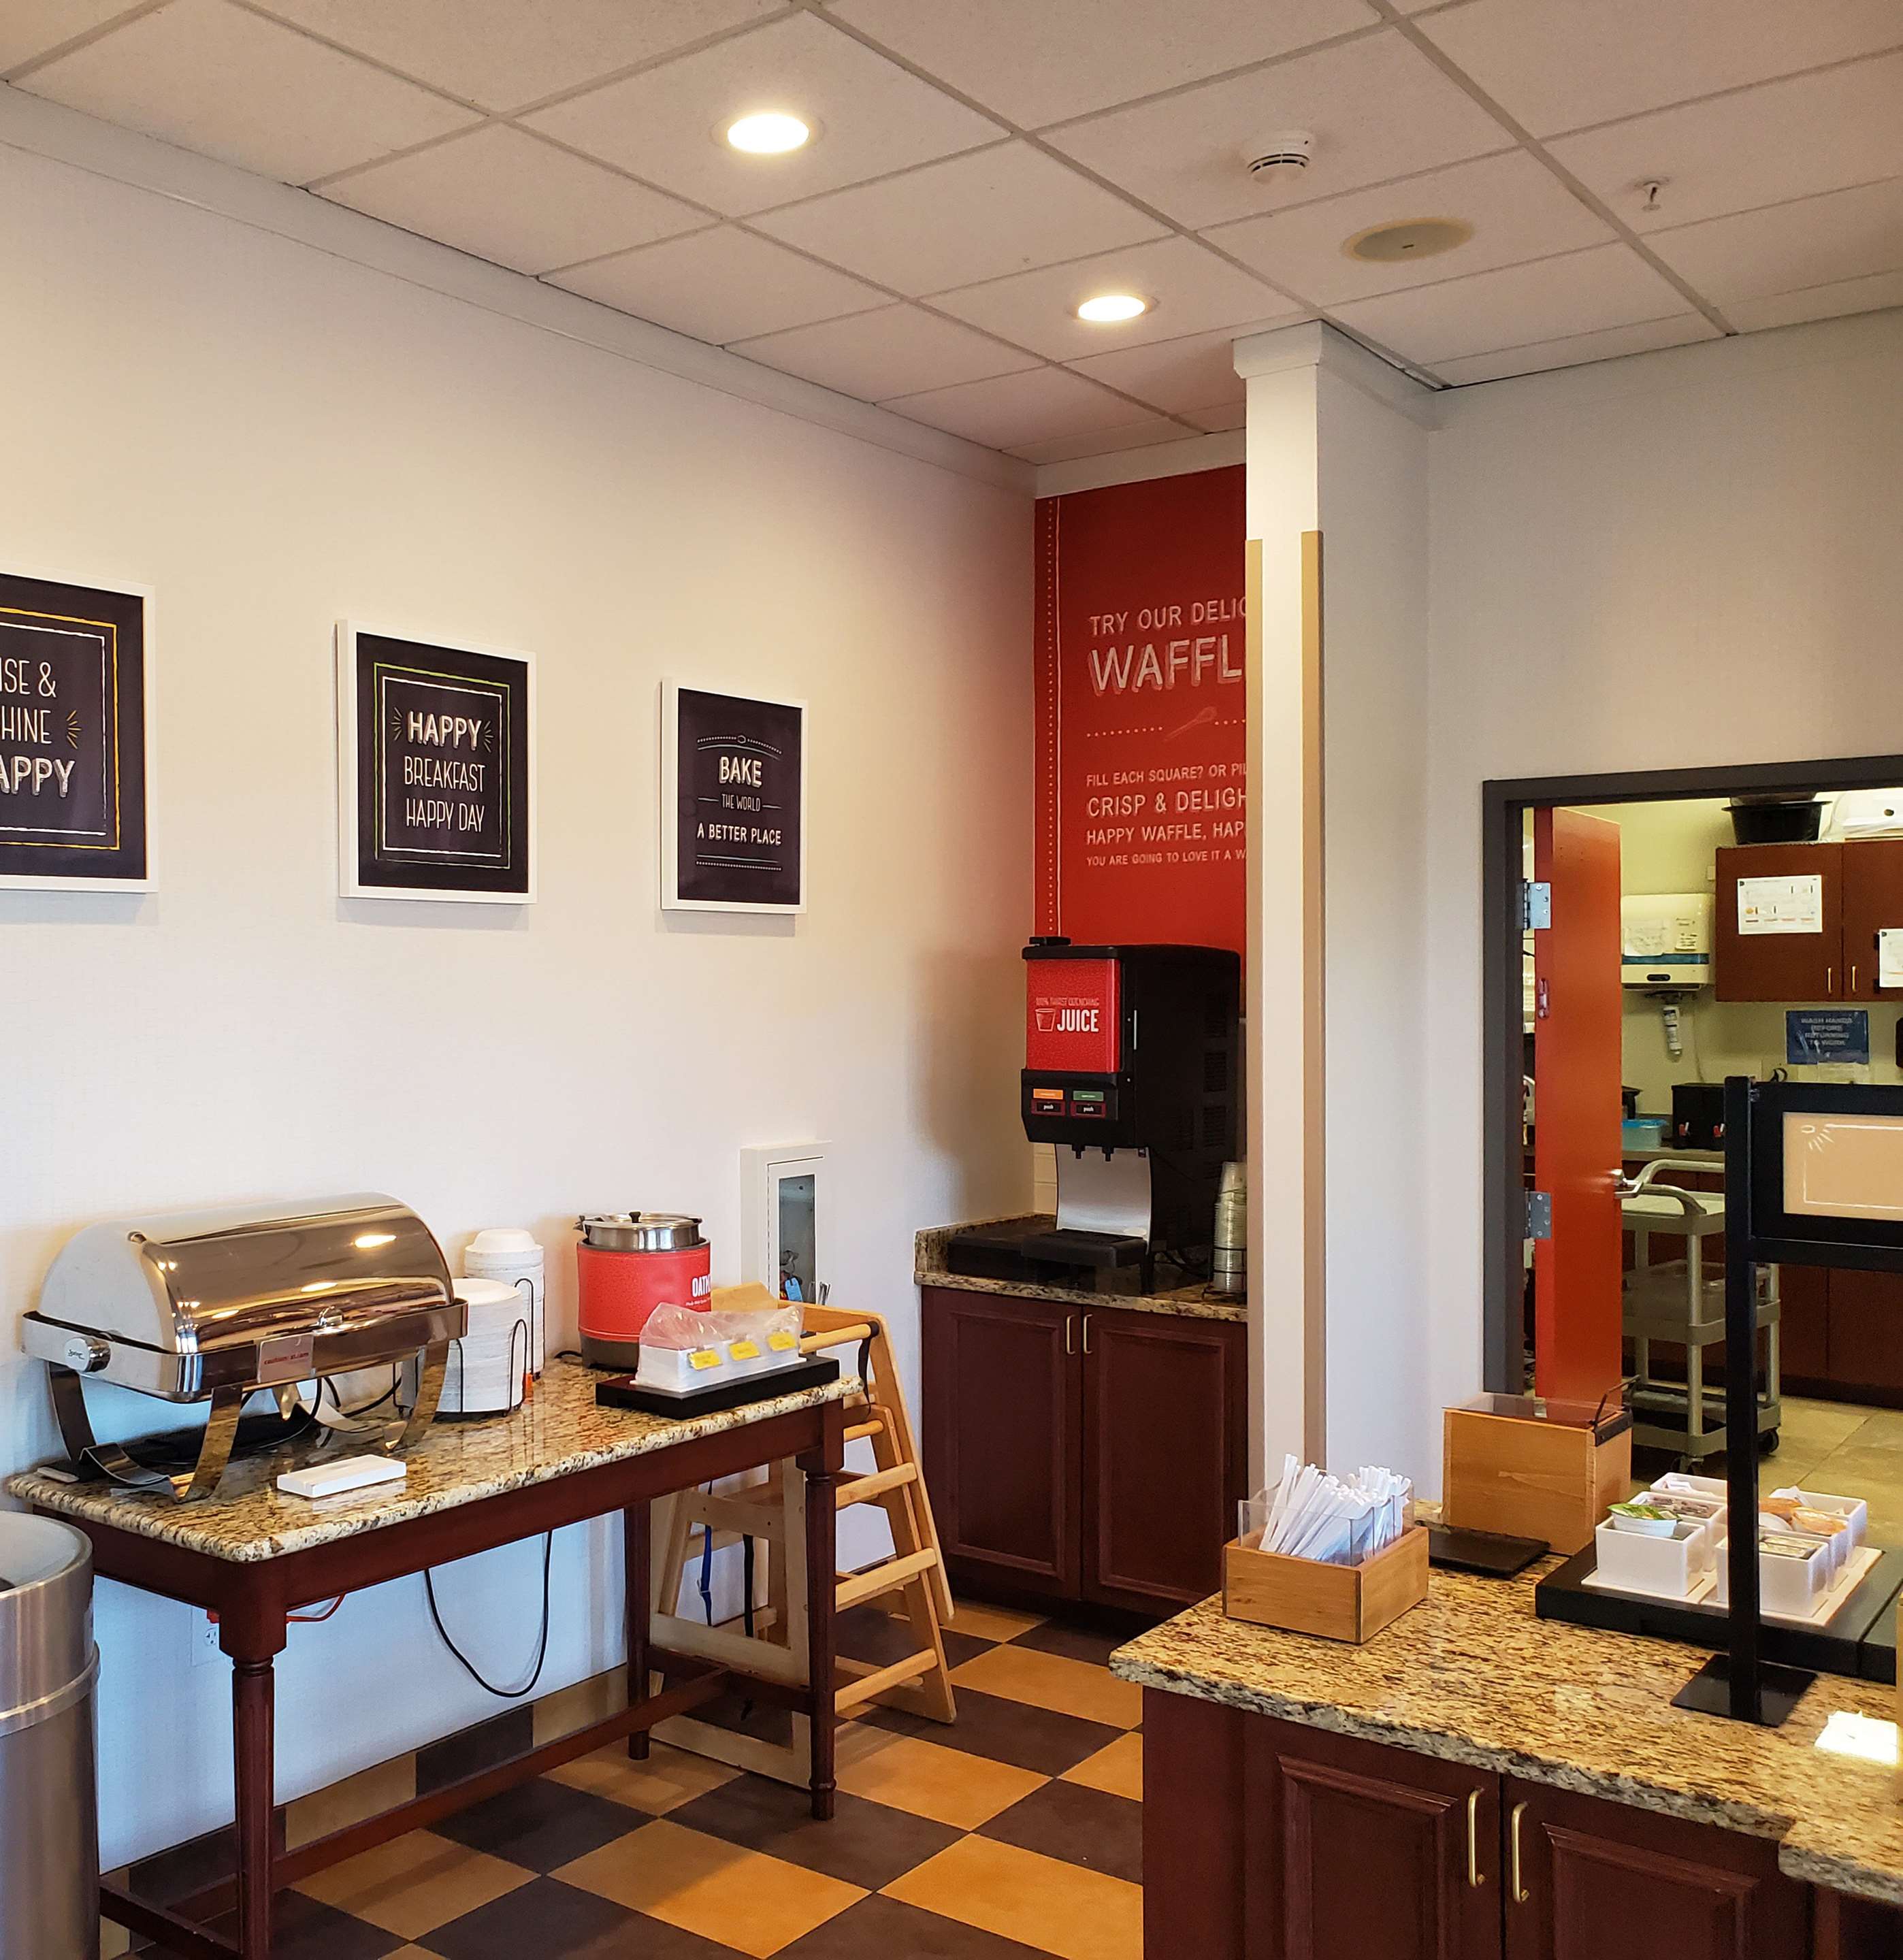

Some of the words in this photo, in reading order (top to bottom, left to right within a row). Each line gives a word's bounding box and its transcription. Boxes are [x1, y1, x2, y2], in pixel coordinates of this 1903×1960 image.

[1089, 611, 1128, 636] TRY
[1137, 605, 1182, 630] OUR
[38, 662, 57, 698] &
[1089, 634, 1243, 696] WAFFL
[1, 705, 53, 744] HINE
[408, 710, 483, 751] HAPPY
[404, 755, 486, 793] BREAKFAST
[719, 755, 763, 787] BAKE
[1087, 774, 1109, 787] FILL
[1113, 770, 1144, 785] EACH
[1148, 766, 1204, 782] SQUARE?
[1209, 764, 1226, 777] OR
[406, 798, 454, 830] HAPPY
[459, 802, 485, 833] DAY
[721, 793, 735, 810] THE
[736, 796, 761, 812] WORLD
[1088, 794, 1146, 817] CRISP
[1155, 791, 1167, 814] &
[696, 822, 705, 839] A
[709, 823, 748, 843] BETTER
[751, 828, 782, 846] PLACE
[1087, 826, 1135, 845] HAPPY
[1087, 855, 1106, 866] YOU
[1109, 854, 1129, 866] ARE
[1132, 852, 1162, 864] GOING
[1166, 851, 1180, 863] TO
[1182, 850, 1209, 862] LOVE
[1211, 849, 1220, 861] IT
[1224, 849, 1232, 860] A
[1056, 1009, 1100, 1032] JUICE
